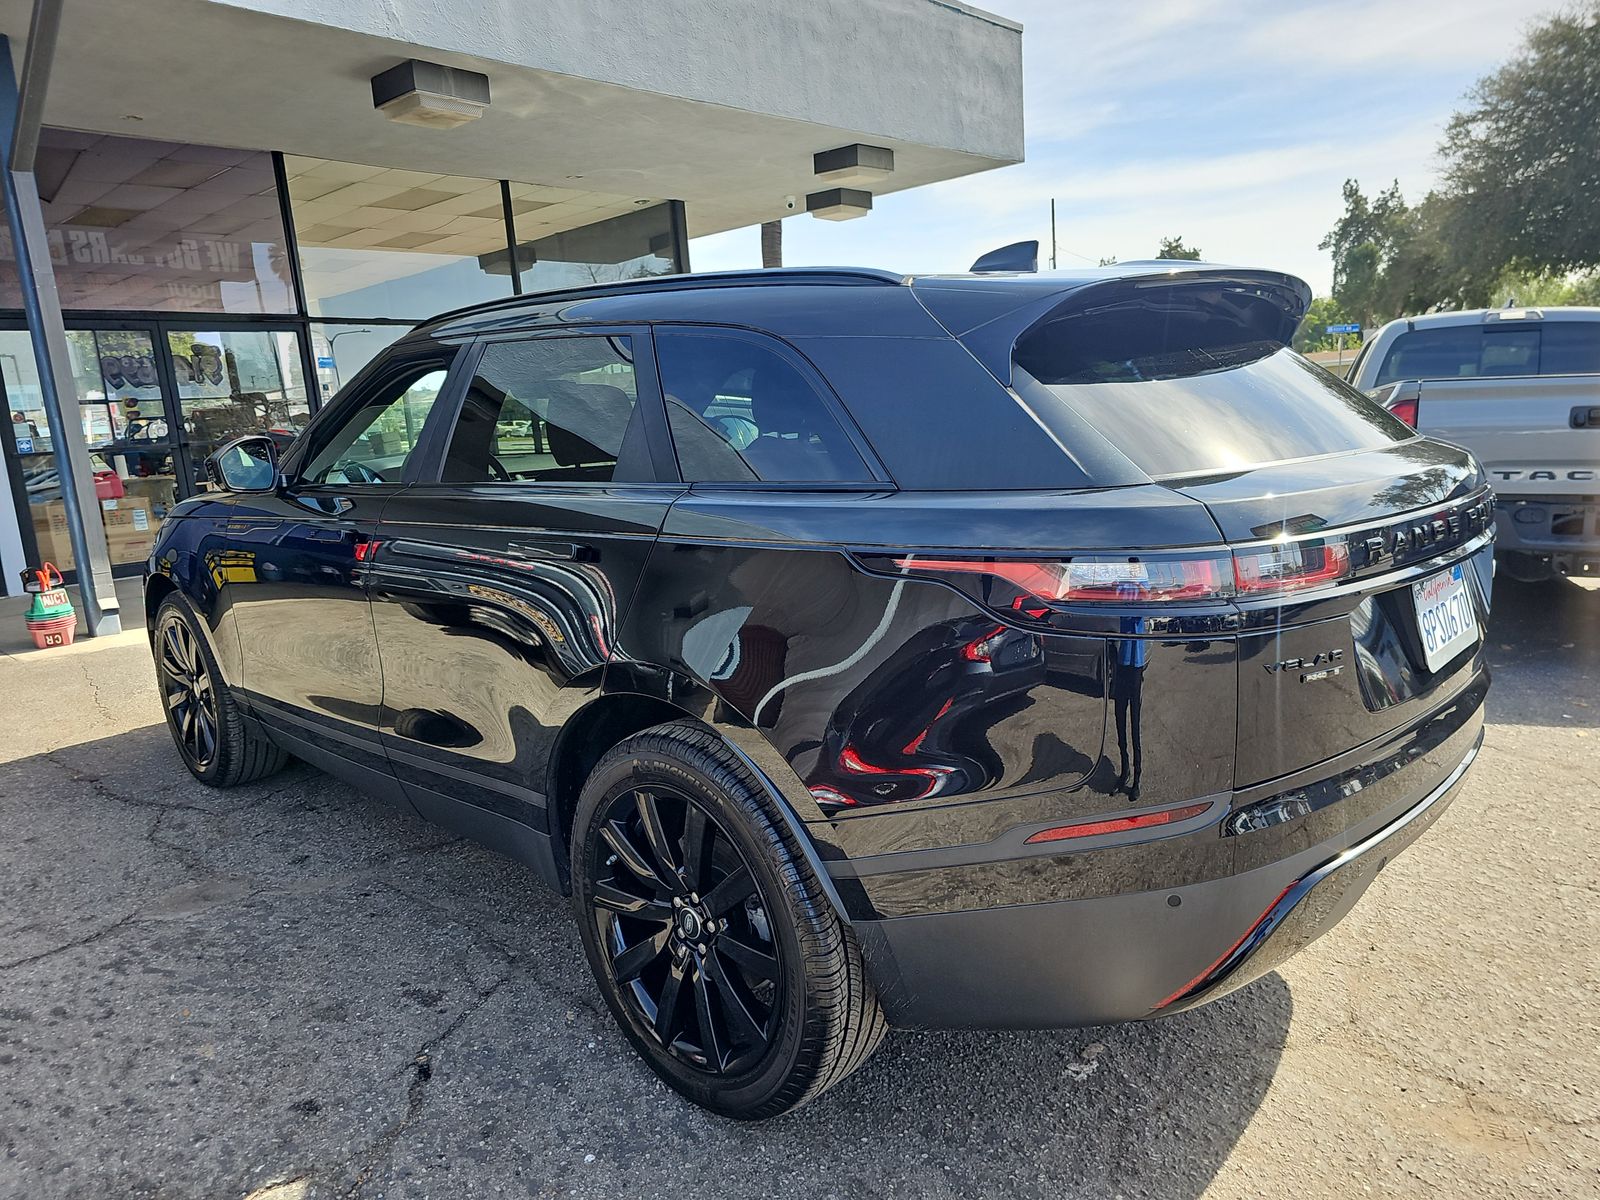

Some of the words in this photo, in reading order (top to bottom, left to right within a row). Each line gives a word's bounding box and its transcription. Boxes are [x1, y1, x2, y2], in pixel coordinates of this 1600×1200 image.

[1366, 516, 1460, 562] RANGE
[1423, 576, 1455, 601] California
[1422, 591, 1473, 653] 8PSD670
[1263, 649, 1343, 674] VELAR
